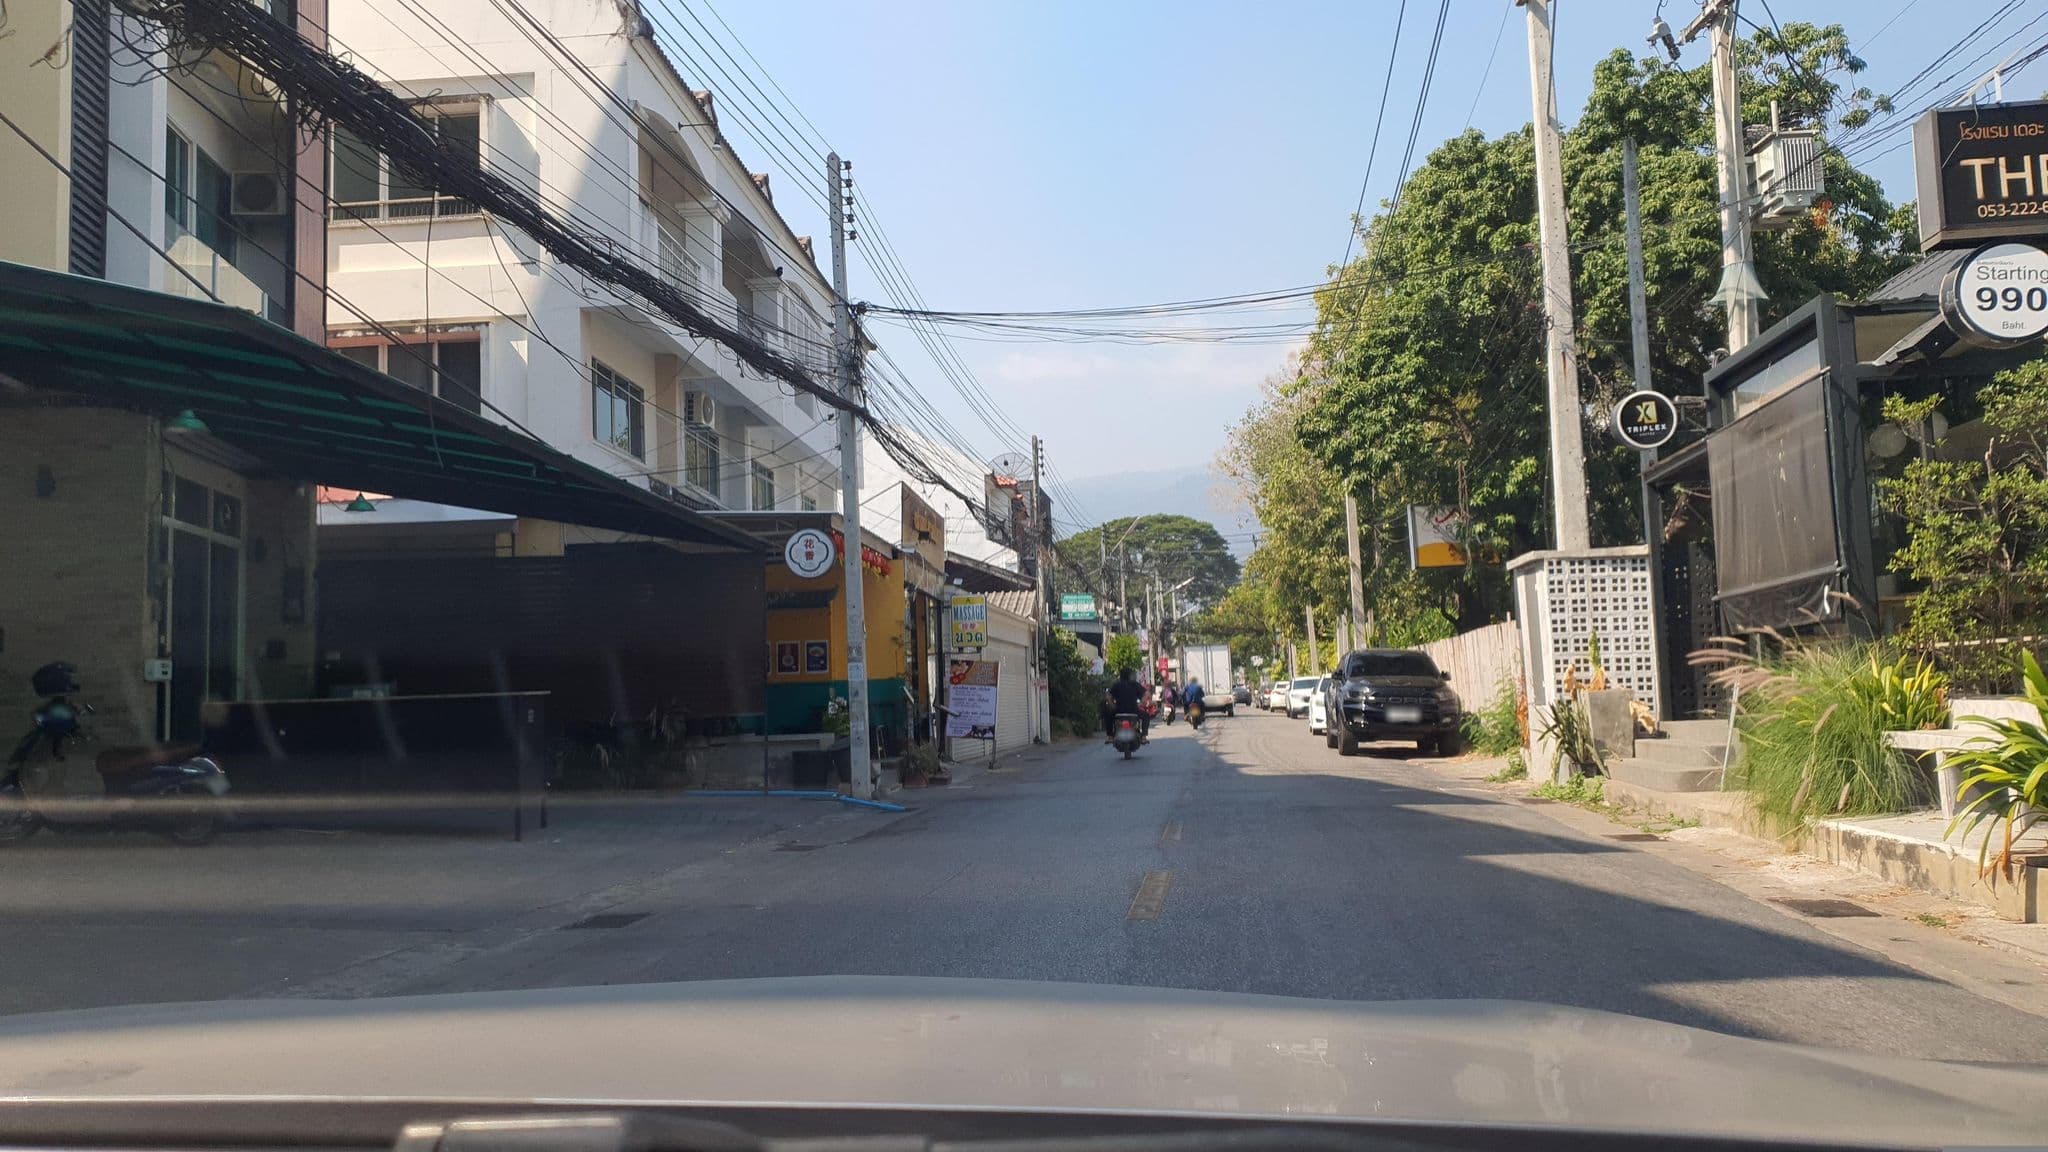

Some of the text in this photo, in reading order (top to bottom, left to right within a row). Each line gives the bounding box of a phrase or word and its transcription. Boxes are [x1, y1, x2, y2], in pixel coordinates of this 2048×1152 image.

[1959, 121, 2045, 141] โรงแรม เดอะ
[1976, 265, 2048, 284] Starting
[1976, 286, 2048, 312] 990
[1626, 423, 1667, 433] TRIPLEX
[953, 605, 985, 621] MASSAGE
